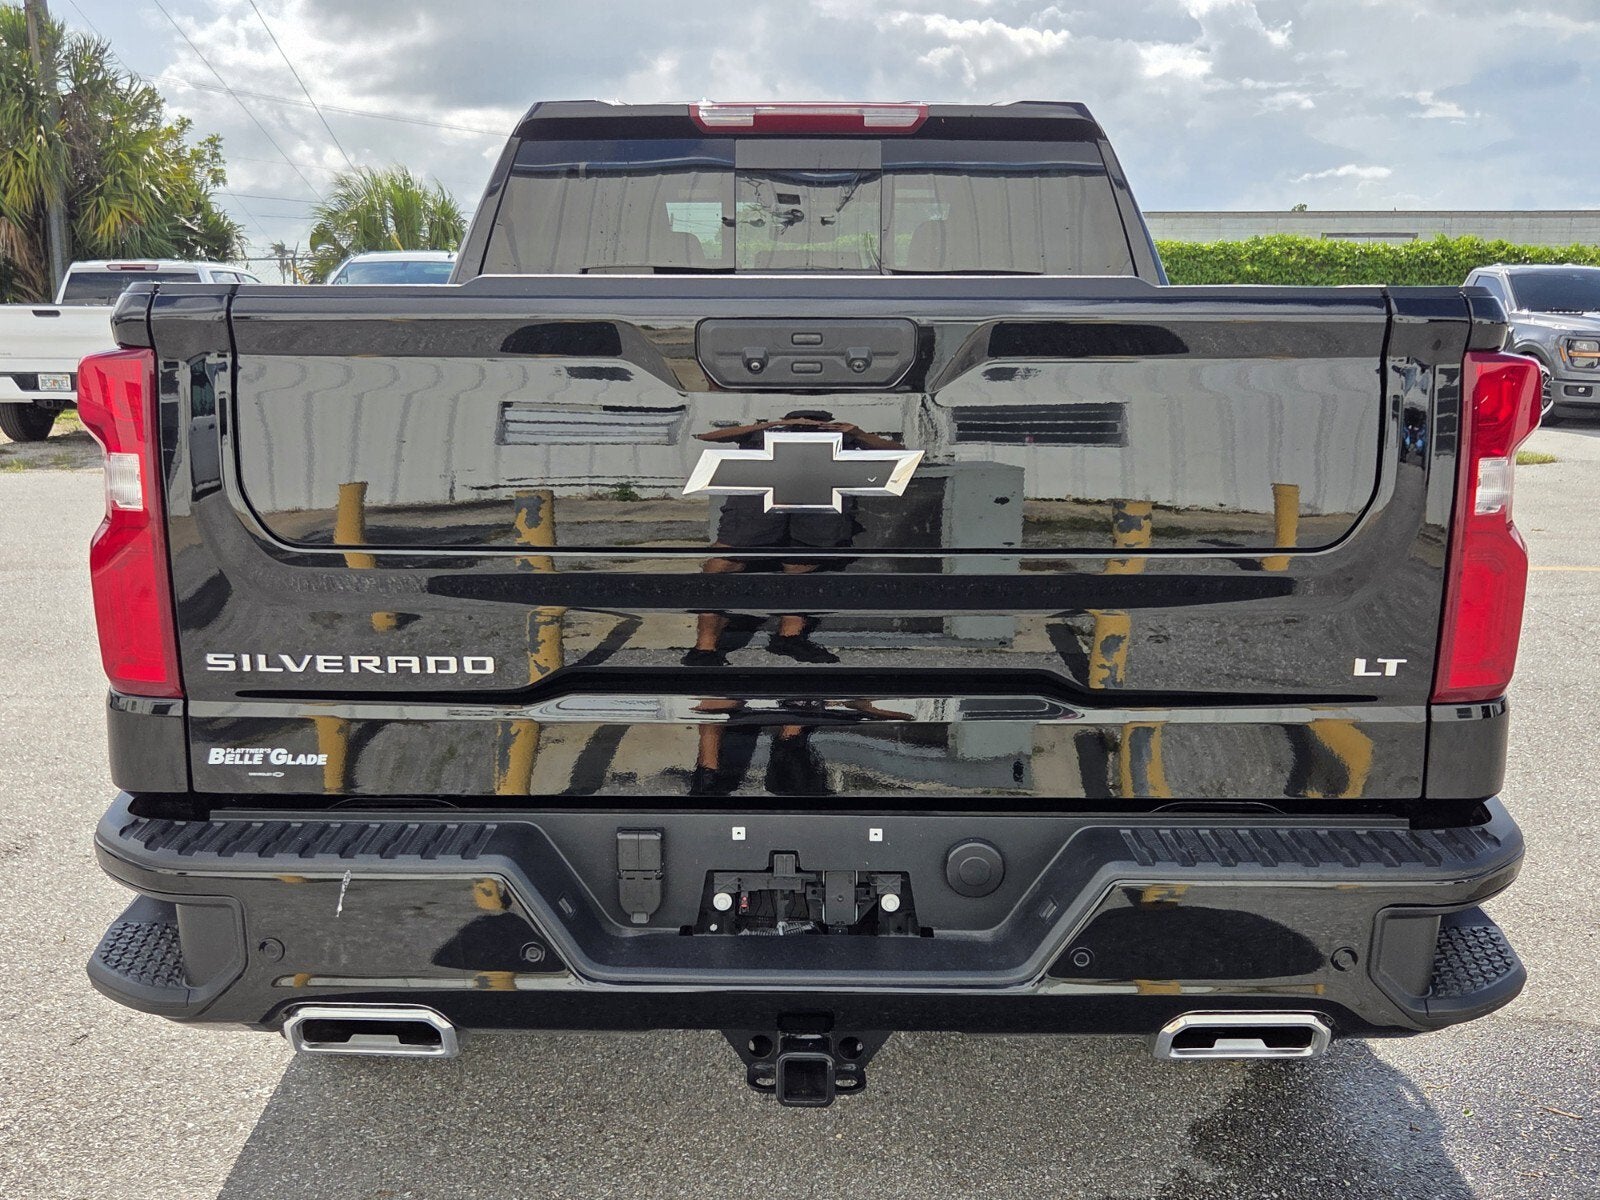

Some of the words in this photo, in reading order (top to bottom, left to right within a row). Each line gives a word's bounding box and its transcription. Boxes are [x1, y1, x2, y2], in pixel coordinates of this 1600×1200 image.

[206, 653, 495, 674] SILVERADO
[1353, 658, 1408, 676] LT
[208, 748, 264, 765] BELLE
[269, 748, 329, 766] GLADE
